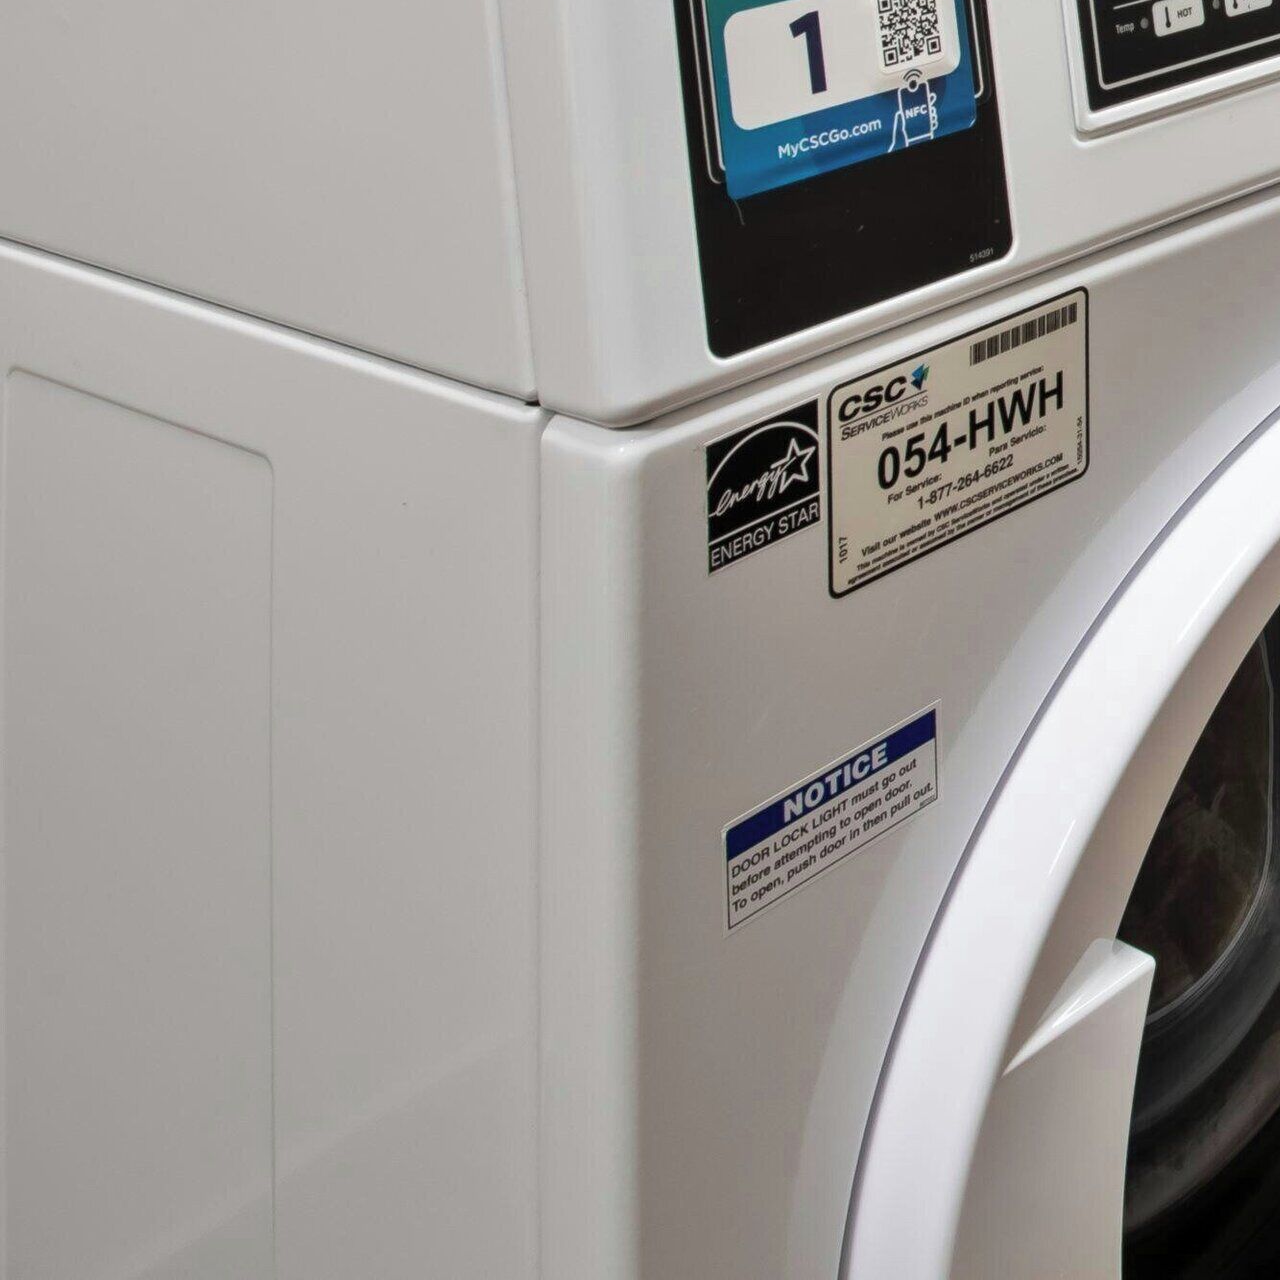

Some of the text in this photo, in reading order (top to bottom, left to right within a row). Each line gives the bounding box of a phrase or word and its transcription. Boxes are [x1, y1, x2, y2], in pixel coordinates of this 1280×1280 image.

[1116, 22, 1135, 34] Temp
[1176, 6, 1192, 19] HOT
[789, 10, 827, 94] 1
[777, 119, 882, 158] MyCSCGo.com
[905, 103, 928, 119] NFC
[838, 375, 907, 422] CSC
[877, 372, 1063, 488] 054-HWH
[881, 365, 1044, 441] Please use this machine ID when reporting service:
[989, 424, 1046, 457] Para Servicio:
[861, 453, 1062, 557] Visit our website WWW.CSCSERVICEWORKS.COM
[887, 473, 942, 504] For Service:
[918, 453, 1013, 508] 1-877-264-6622
[711, 501, 818, 566] ENERGY STAR
[783, 742, 887, 821] NOTICE
[731, 757, 916, 878] DOOR LOCK LIGHT must go out
[731, 865, 770, 896] before
[774, 825, 836, 870] attempting
[839, 816, 851, 829] to
[853, 797, 881, 821] open
[884, 779, 912, 802] door.
[732, 894, 747, 913] To
[750, 876, 784, 902] open,
[787, 854, 816, 882] push
[819, 835, 845, 859] door
[849, 827, 859, 841] in
[862, 810, 887, 832] then
[890, 793, 910, 817] pull
[913, 782, 933, 801] out.
